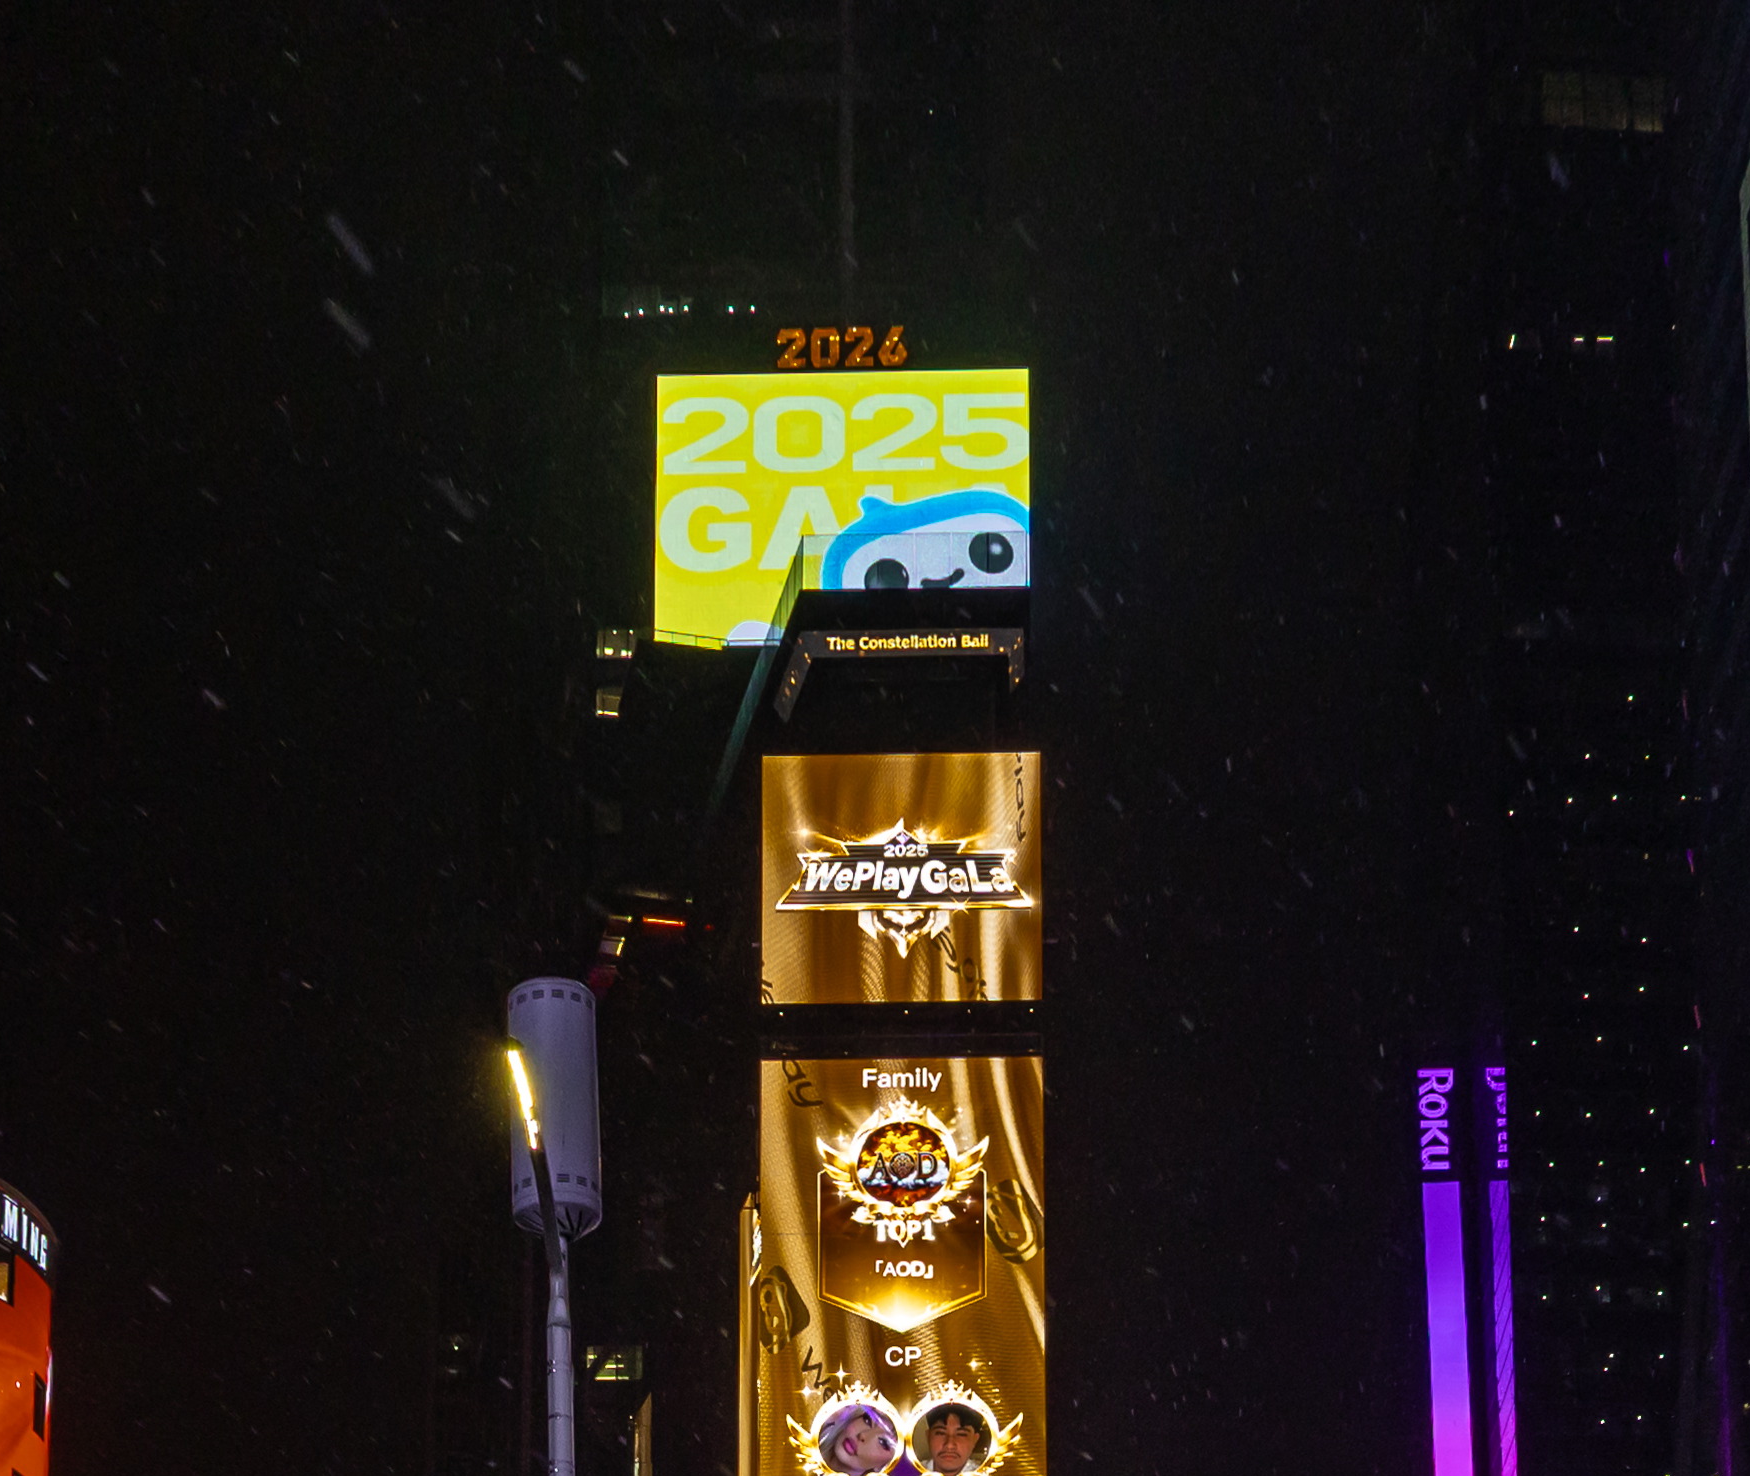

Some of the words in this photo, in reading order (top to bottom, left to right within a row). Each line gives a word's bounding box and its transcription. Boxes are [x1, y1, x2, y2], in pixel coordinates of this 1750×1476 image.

[776, 325, 909, 369] 2026
[662, 392, 1029, 476] 2025
[826, 636, 855, 650] The
[859, 634, 957, 650] Constellation
[961, 632, 989, 648] Ball
[883, 844, 929, 857] 2025
[805, 860, 1015, 899] WePlayGaLa
[861, 1067, 942, 1092] Family
[868, 1152, 938, 1181] AOD
[873, 1219, 936, 1242] TOP1
[885, 1346, 922, 1367] CP
